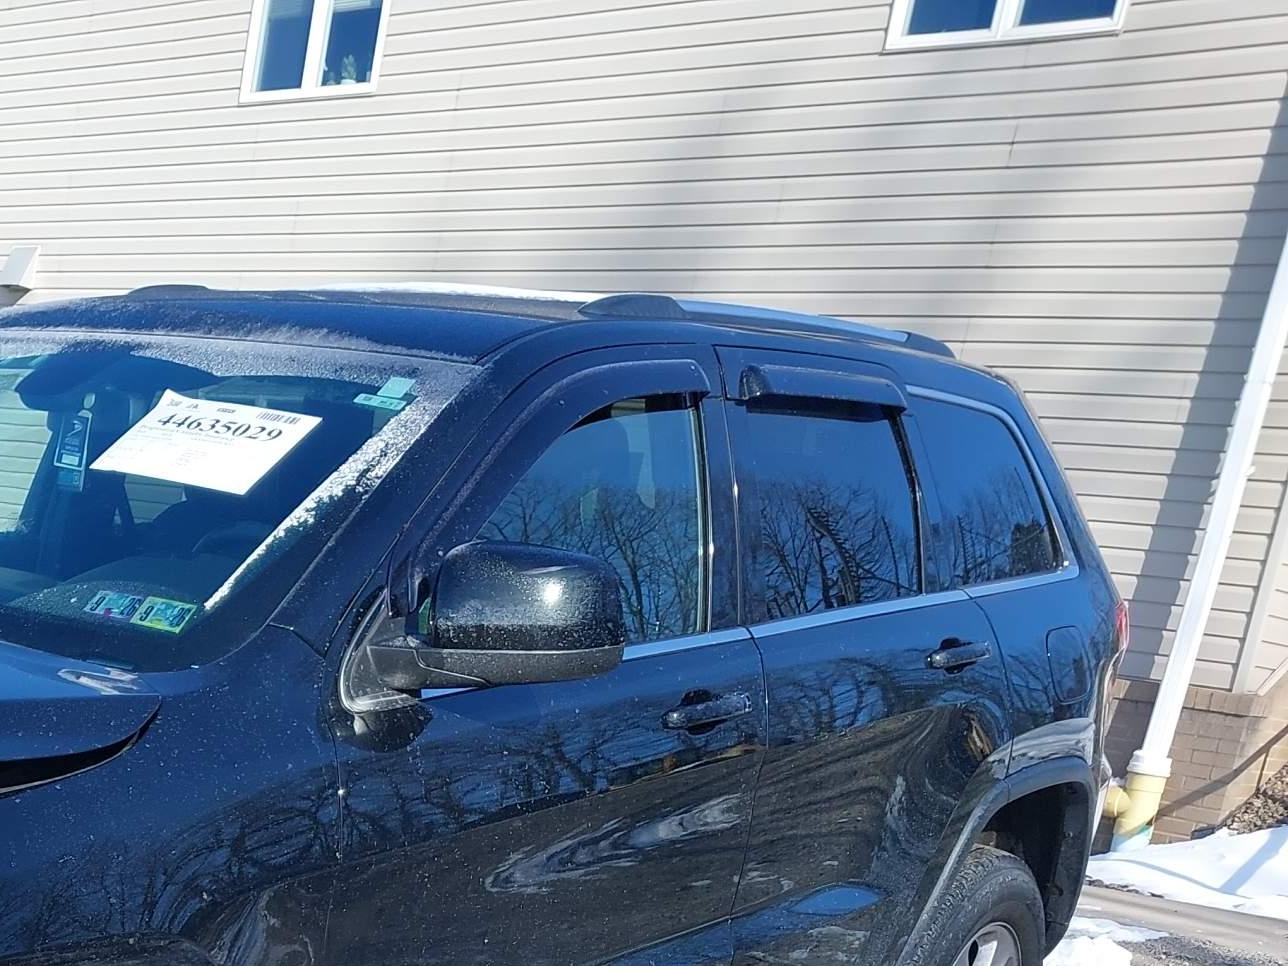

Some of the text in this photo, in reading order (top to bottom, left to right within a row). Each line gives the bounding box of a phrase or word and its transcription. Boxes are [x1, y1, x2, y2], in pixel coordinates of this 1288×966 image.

[157, 413, 284, 442] 44635029
[90, 595, 141, 617] 9 26
[139, 605, 191, 627] 9 26
